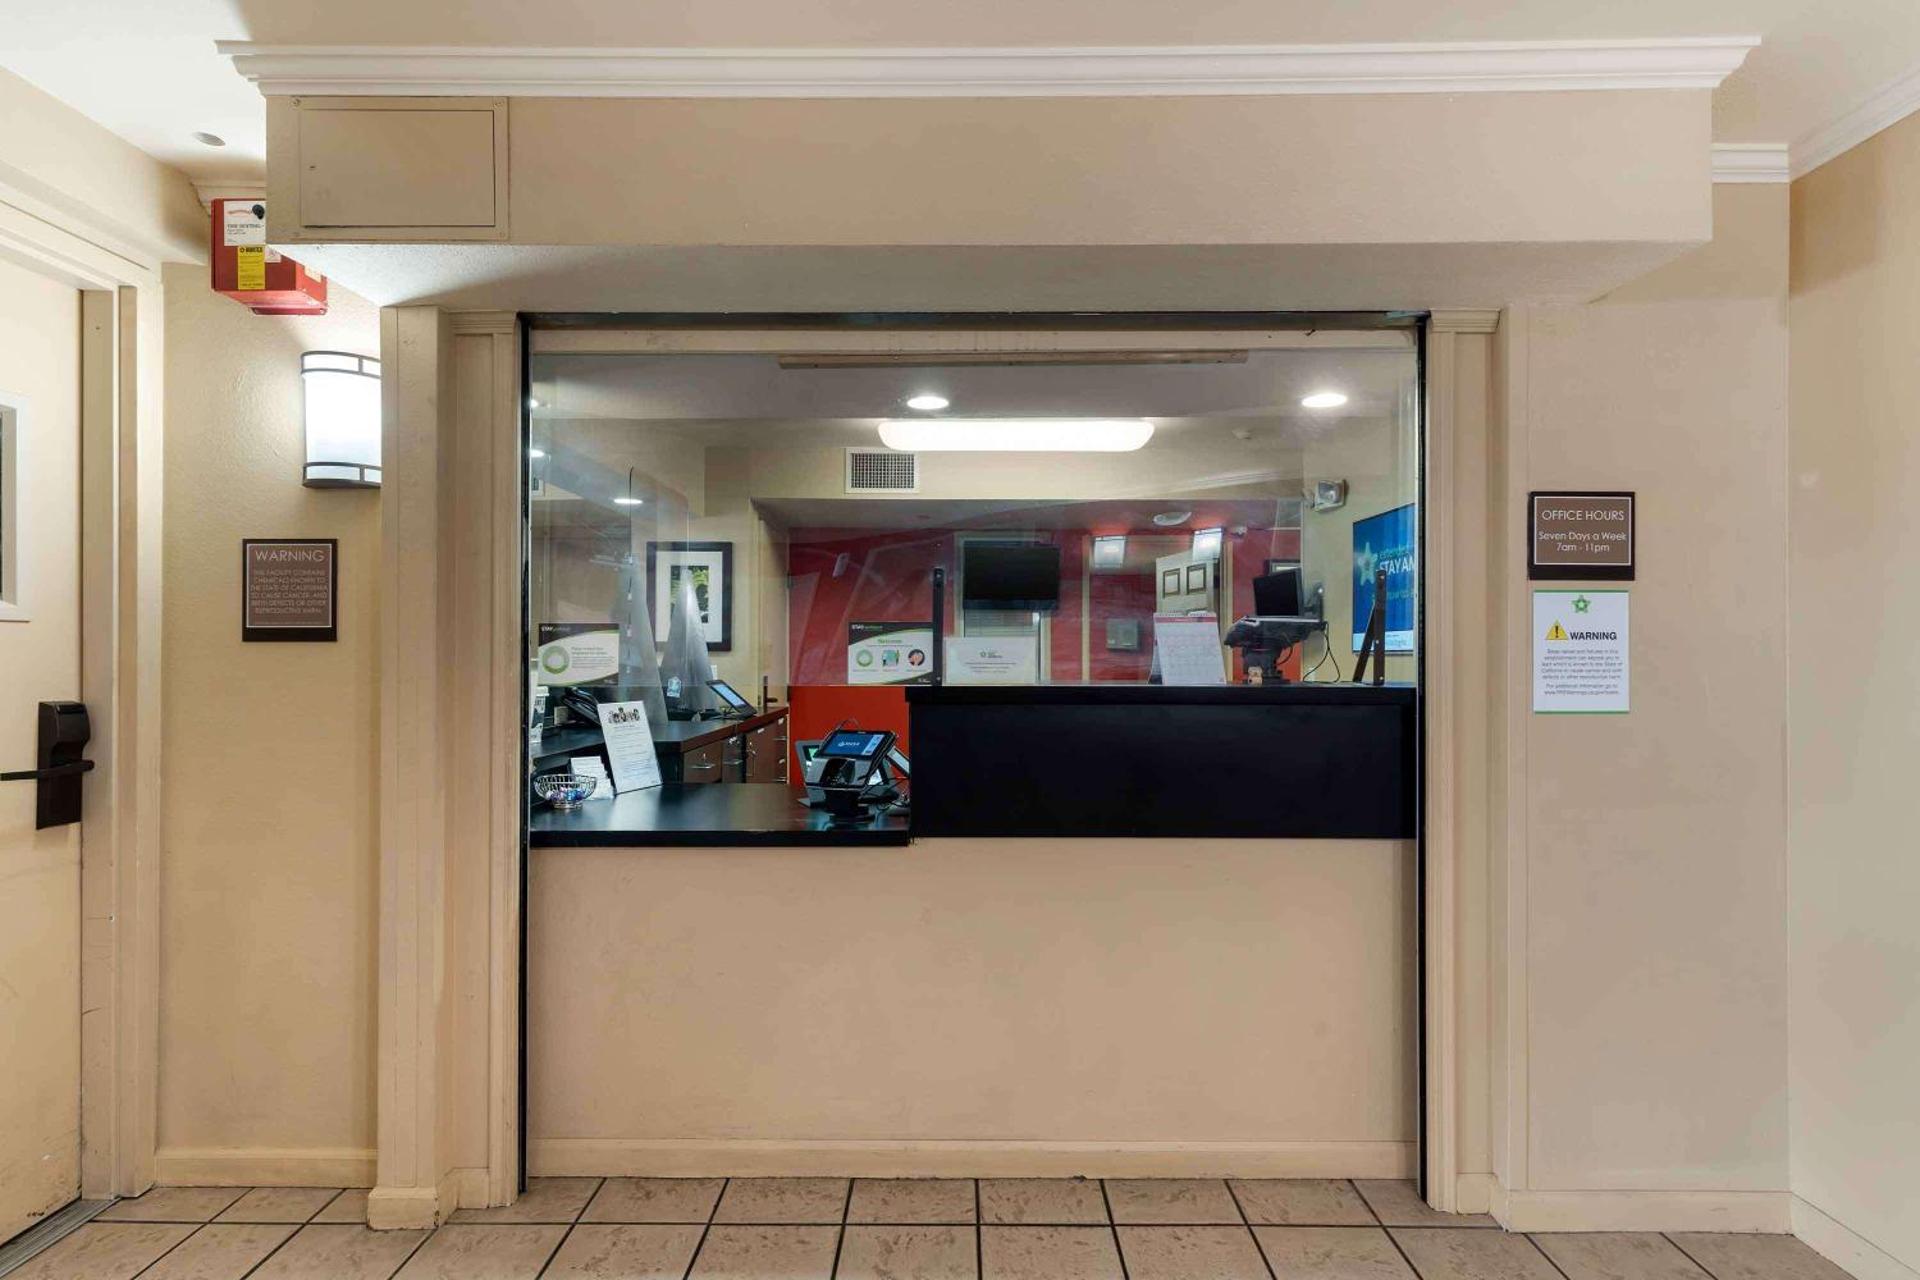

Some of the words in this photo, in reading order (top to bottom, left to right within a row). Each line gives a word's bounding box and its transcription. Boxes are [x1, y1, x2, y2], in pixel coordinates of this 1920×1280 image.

[1541, 510, 1583, 521] OFFICE
[1585, 510, 1624, 521] HOURS
[1538, 532, 1567, 540] Seven
[1568, 532, 1591, 542] Days
[1600, 532, 1627, 540] Week
[1556, 542, 1576, 552] 7am
[1585, 542, 1610, 554] 11pm
[255, 550, 326, 562] WARNING
[1570, 632, 1618, 641] WARNING
